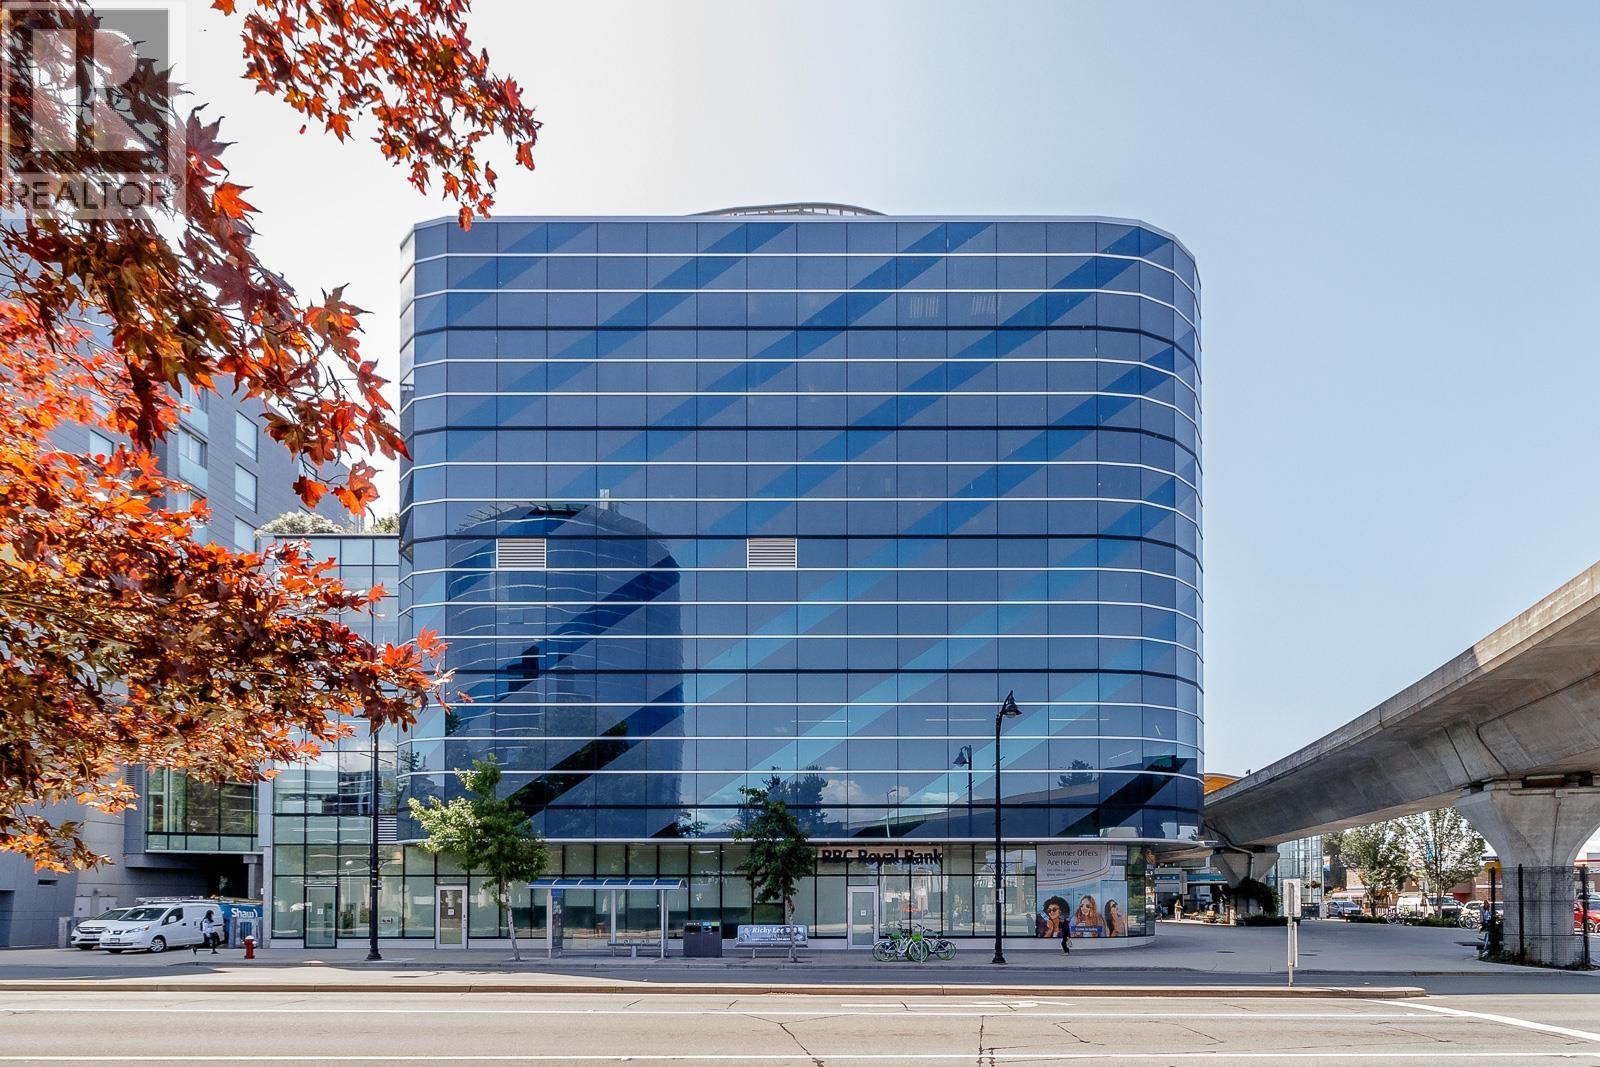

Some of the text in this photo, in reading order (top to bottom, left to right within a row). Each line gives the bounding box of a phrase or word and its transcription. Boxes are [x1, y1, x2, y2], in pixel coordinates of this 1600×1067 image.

[858, 849, 899, 866] Royal
[904, 848, 943, 864] Bank
[1077, 849, 1098, 857] Offers
[231, 907, 256, 918] Shaw
